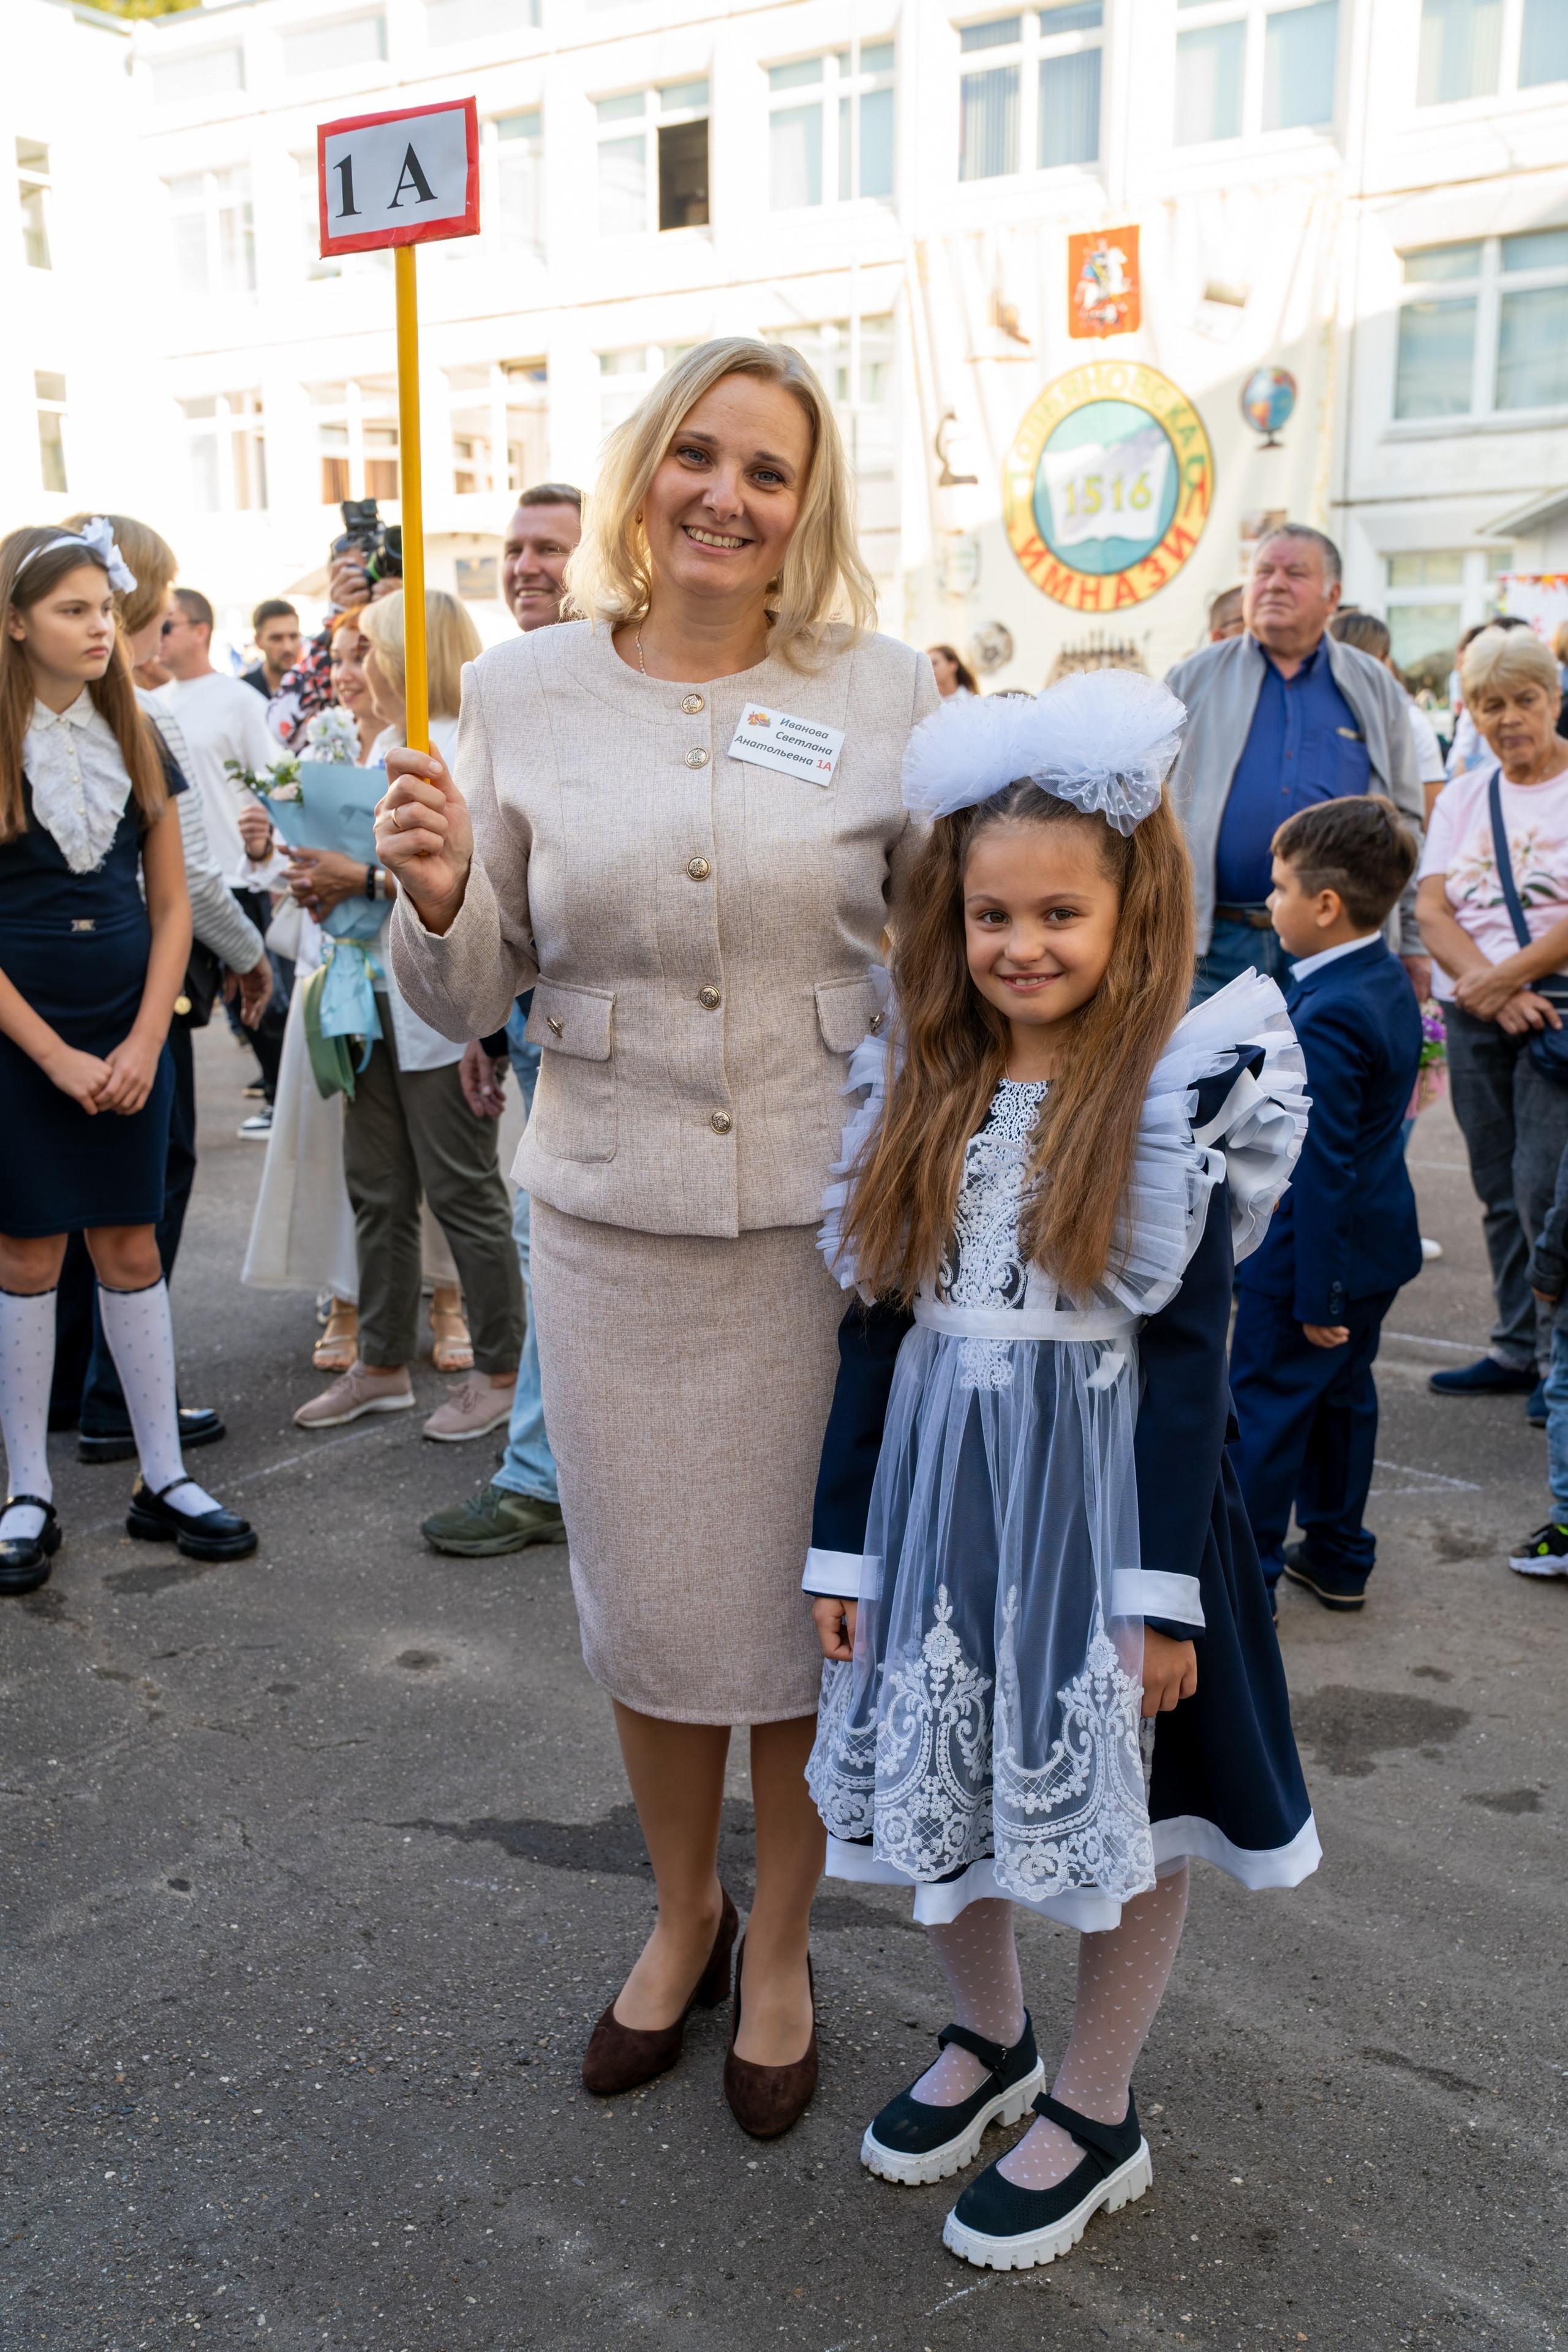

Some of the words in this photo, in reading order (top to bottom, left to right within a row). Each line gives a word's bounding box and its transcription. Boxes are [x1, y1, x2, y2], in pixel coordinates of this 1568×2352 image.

[333, 154, 362, 218] 1
[386, 141, 438, 209] А
[1065, 470, 1152, 516] 1516
[775, 731, 833, 755] Светлана
[779, 717, 829, 739] Иванова
[734, 735, 813, 766] Анатольевна
[816, 759, 832, 772] 1А
